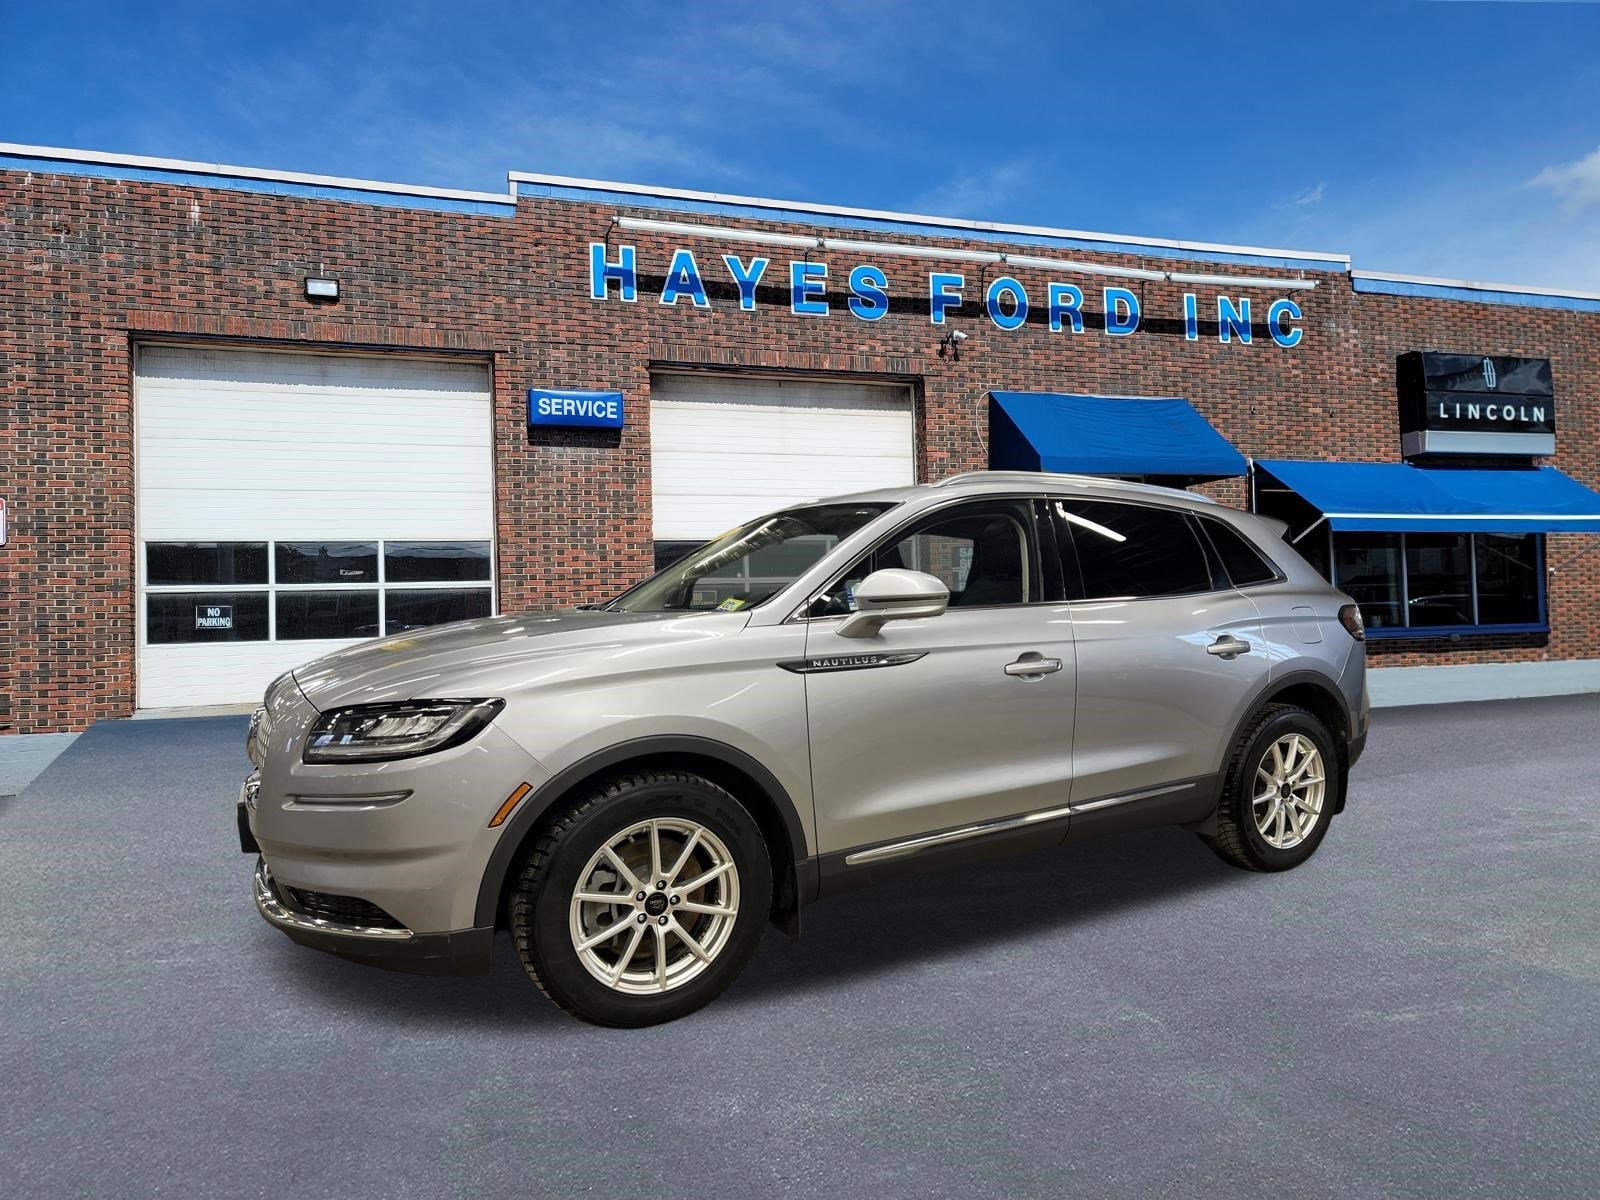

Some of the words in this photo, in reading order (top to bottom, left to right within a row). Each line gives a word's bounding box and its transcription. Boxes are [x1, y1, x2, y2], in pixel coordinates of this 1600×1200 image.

[589, 242, 888, 321] HAYES
[929, 272, 1140, 336] FORD
[1184, 293, 1303, 348] INC
[538, 397, 618, 419] SERVICE
[1439, 402, 1545, 423] LINCOLN
[207, 607, 220, 617] NO
[197, 616, 231, 627] PARKING
[812, 655, 878, 667] NAUTILUS
